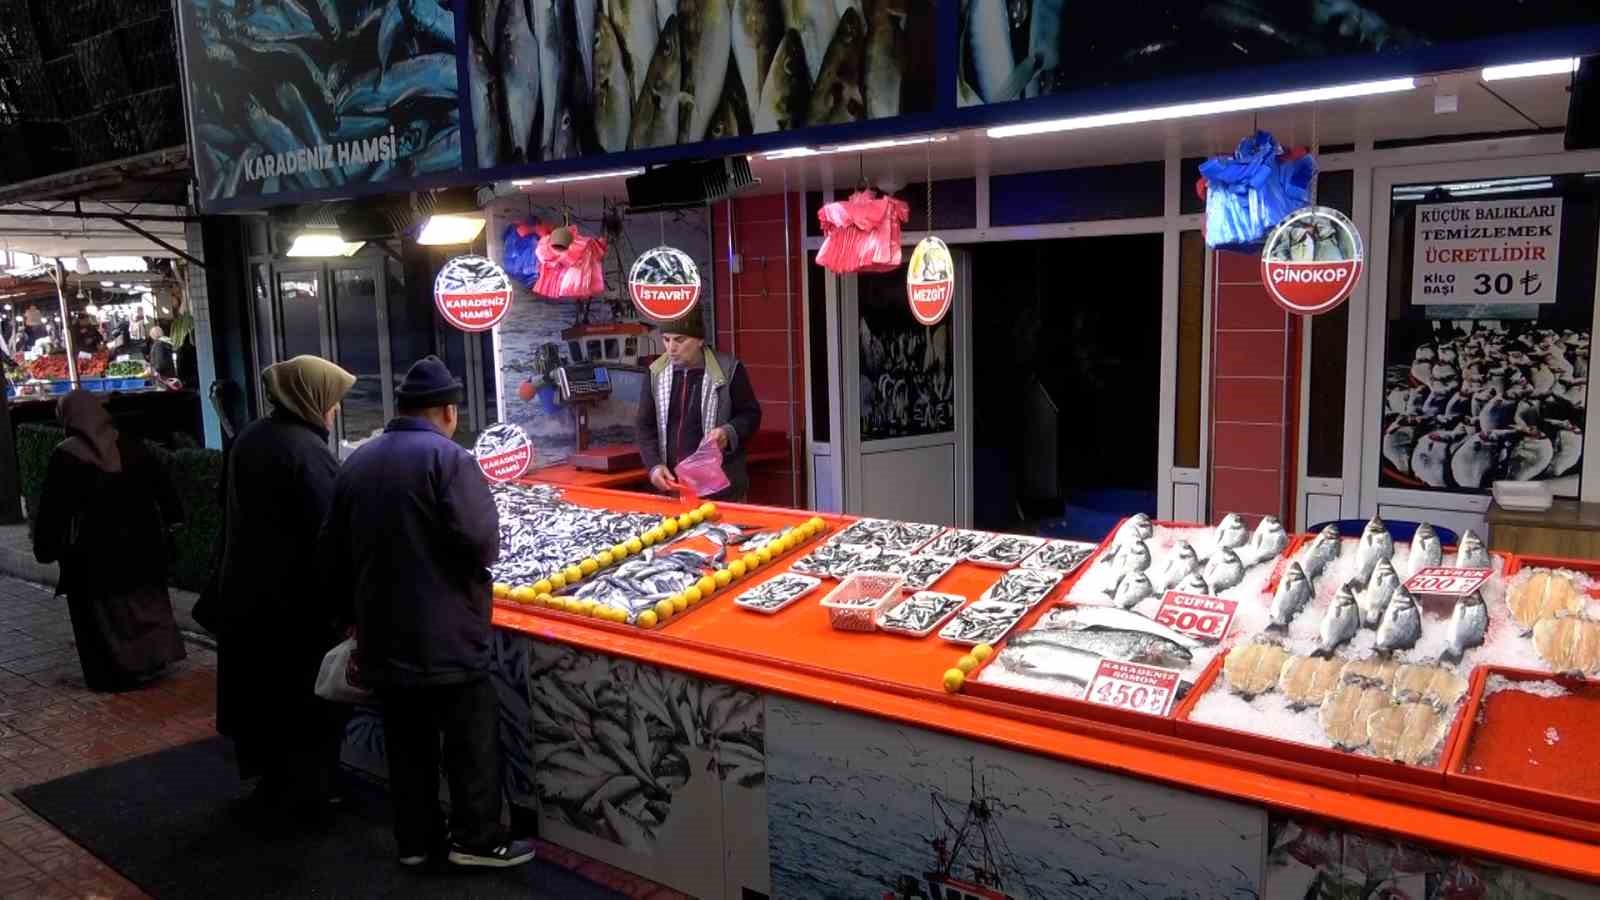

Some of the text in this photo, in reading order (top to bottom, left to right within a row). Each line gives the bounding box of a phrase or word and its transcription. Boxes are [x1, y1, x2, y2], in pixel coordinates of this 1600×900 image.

[337, 125, 397, 166] HAMSİ
[1421, 204, 1556, 225] KÜÇÜK BALIKLARI
[1421, 224, 1553, 241] TEMİZLEMEK
[1425, 241, 1546, 263] ÜCRETLİDİR
[1272, 264, 1347, 284] ÇİNOKOP
[1423, 273, 1456, 283] KİLO
[1473, 272, 1514, 295] 30
[640, 286, 691, 301] İSTAVRİT
[913, 285, 946, 302] MEZGİT
[1423, 284, 1455, 297] BAŞI
[1157, 608, 1219, 634] 500
[1096, 681, 1149, 709] 450
